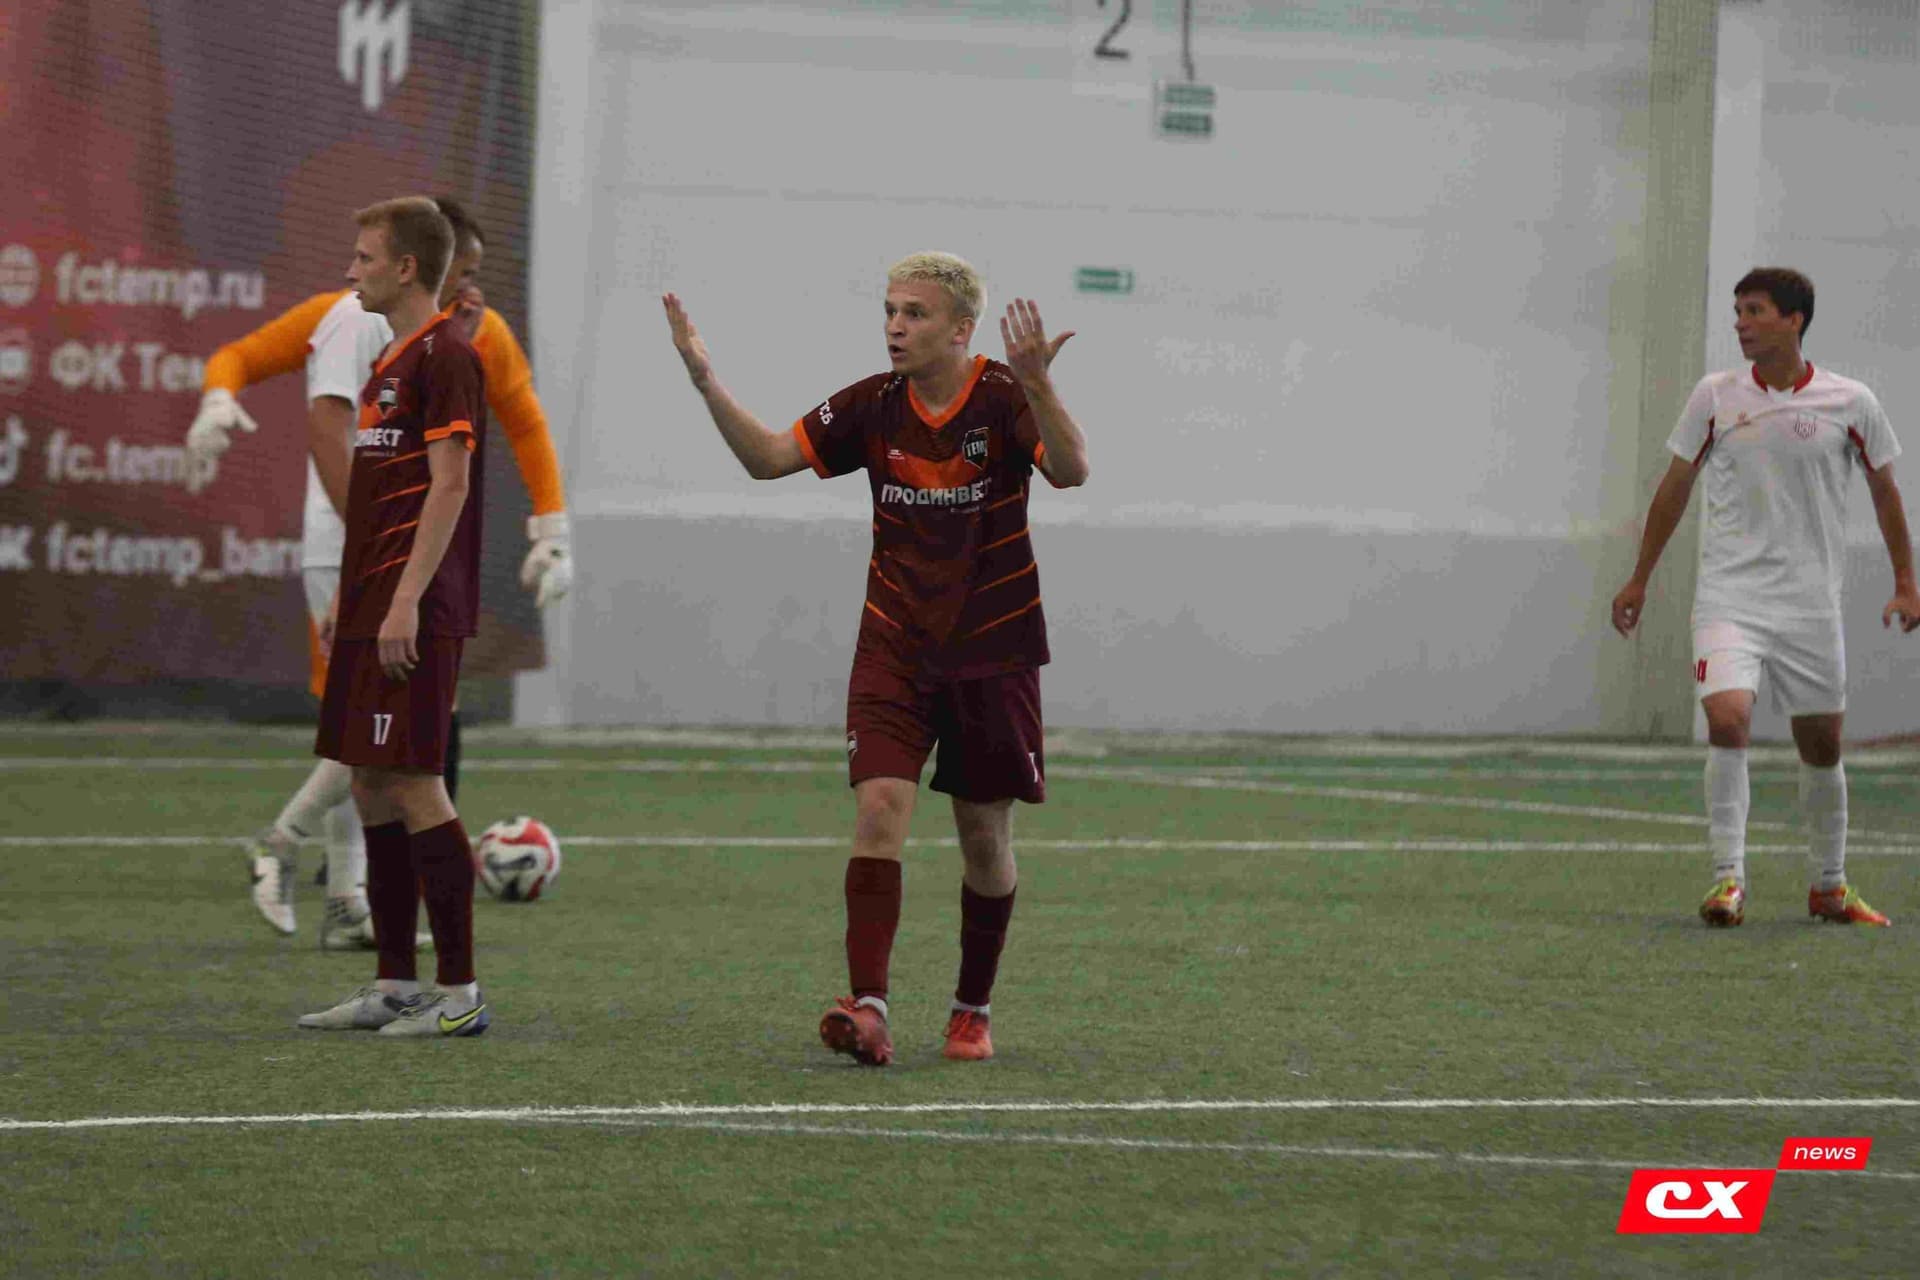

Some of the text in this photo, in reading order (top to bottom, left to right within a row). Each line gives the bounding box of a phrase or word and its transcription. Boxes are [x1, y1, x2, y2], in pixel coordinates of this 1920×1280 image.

[56, 250, 265, 319] fctemp.ru
[51, 341, 125, 392] ФК
[44, 429, 219, 493] fc.temp
[373, 713, 393, 745] 17
